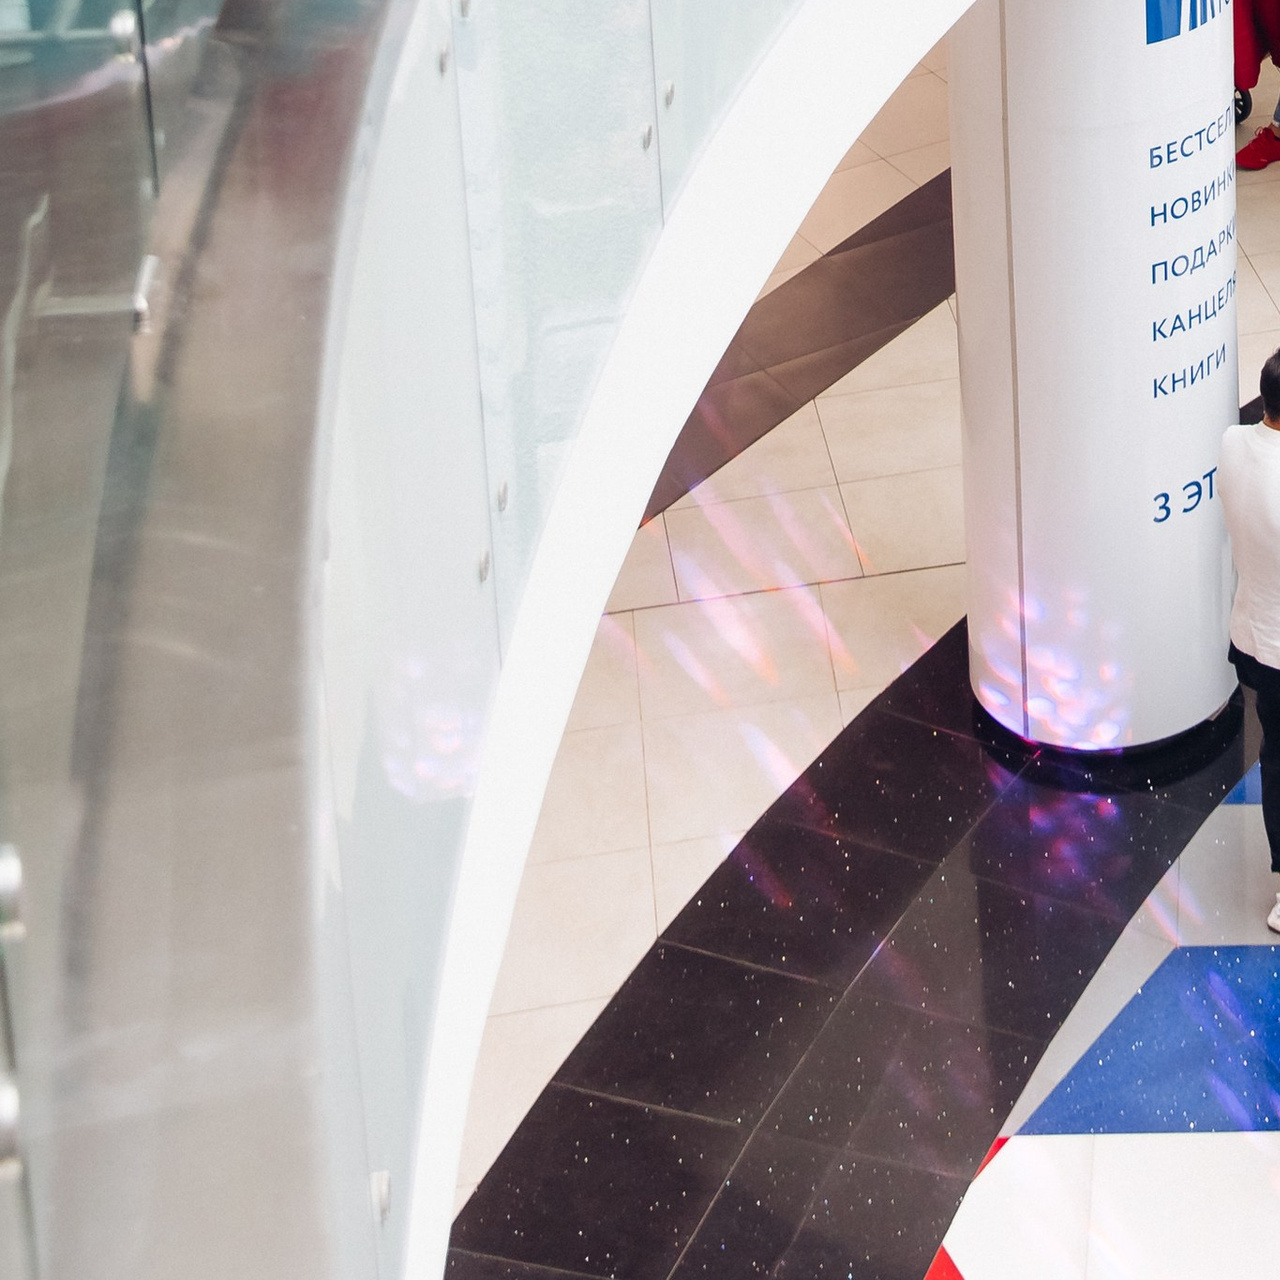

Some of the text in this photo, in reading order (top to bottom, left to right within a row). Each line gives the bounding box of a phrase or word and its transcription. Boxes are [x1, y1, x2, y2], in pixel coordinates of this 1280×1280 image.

[1153, 343, 1226, 398] КНИГИ
[1153, 465, 1218, 523] 3 ЭТ
